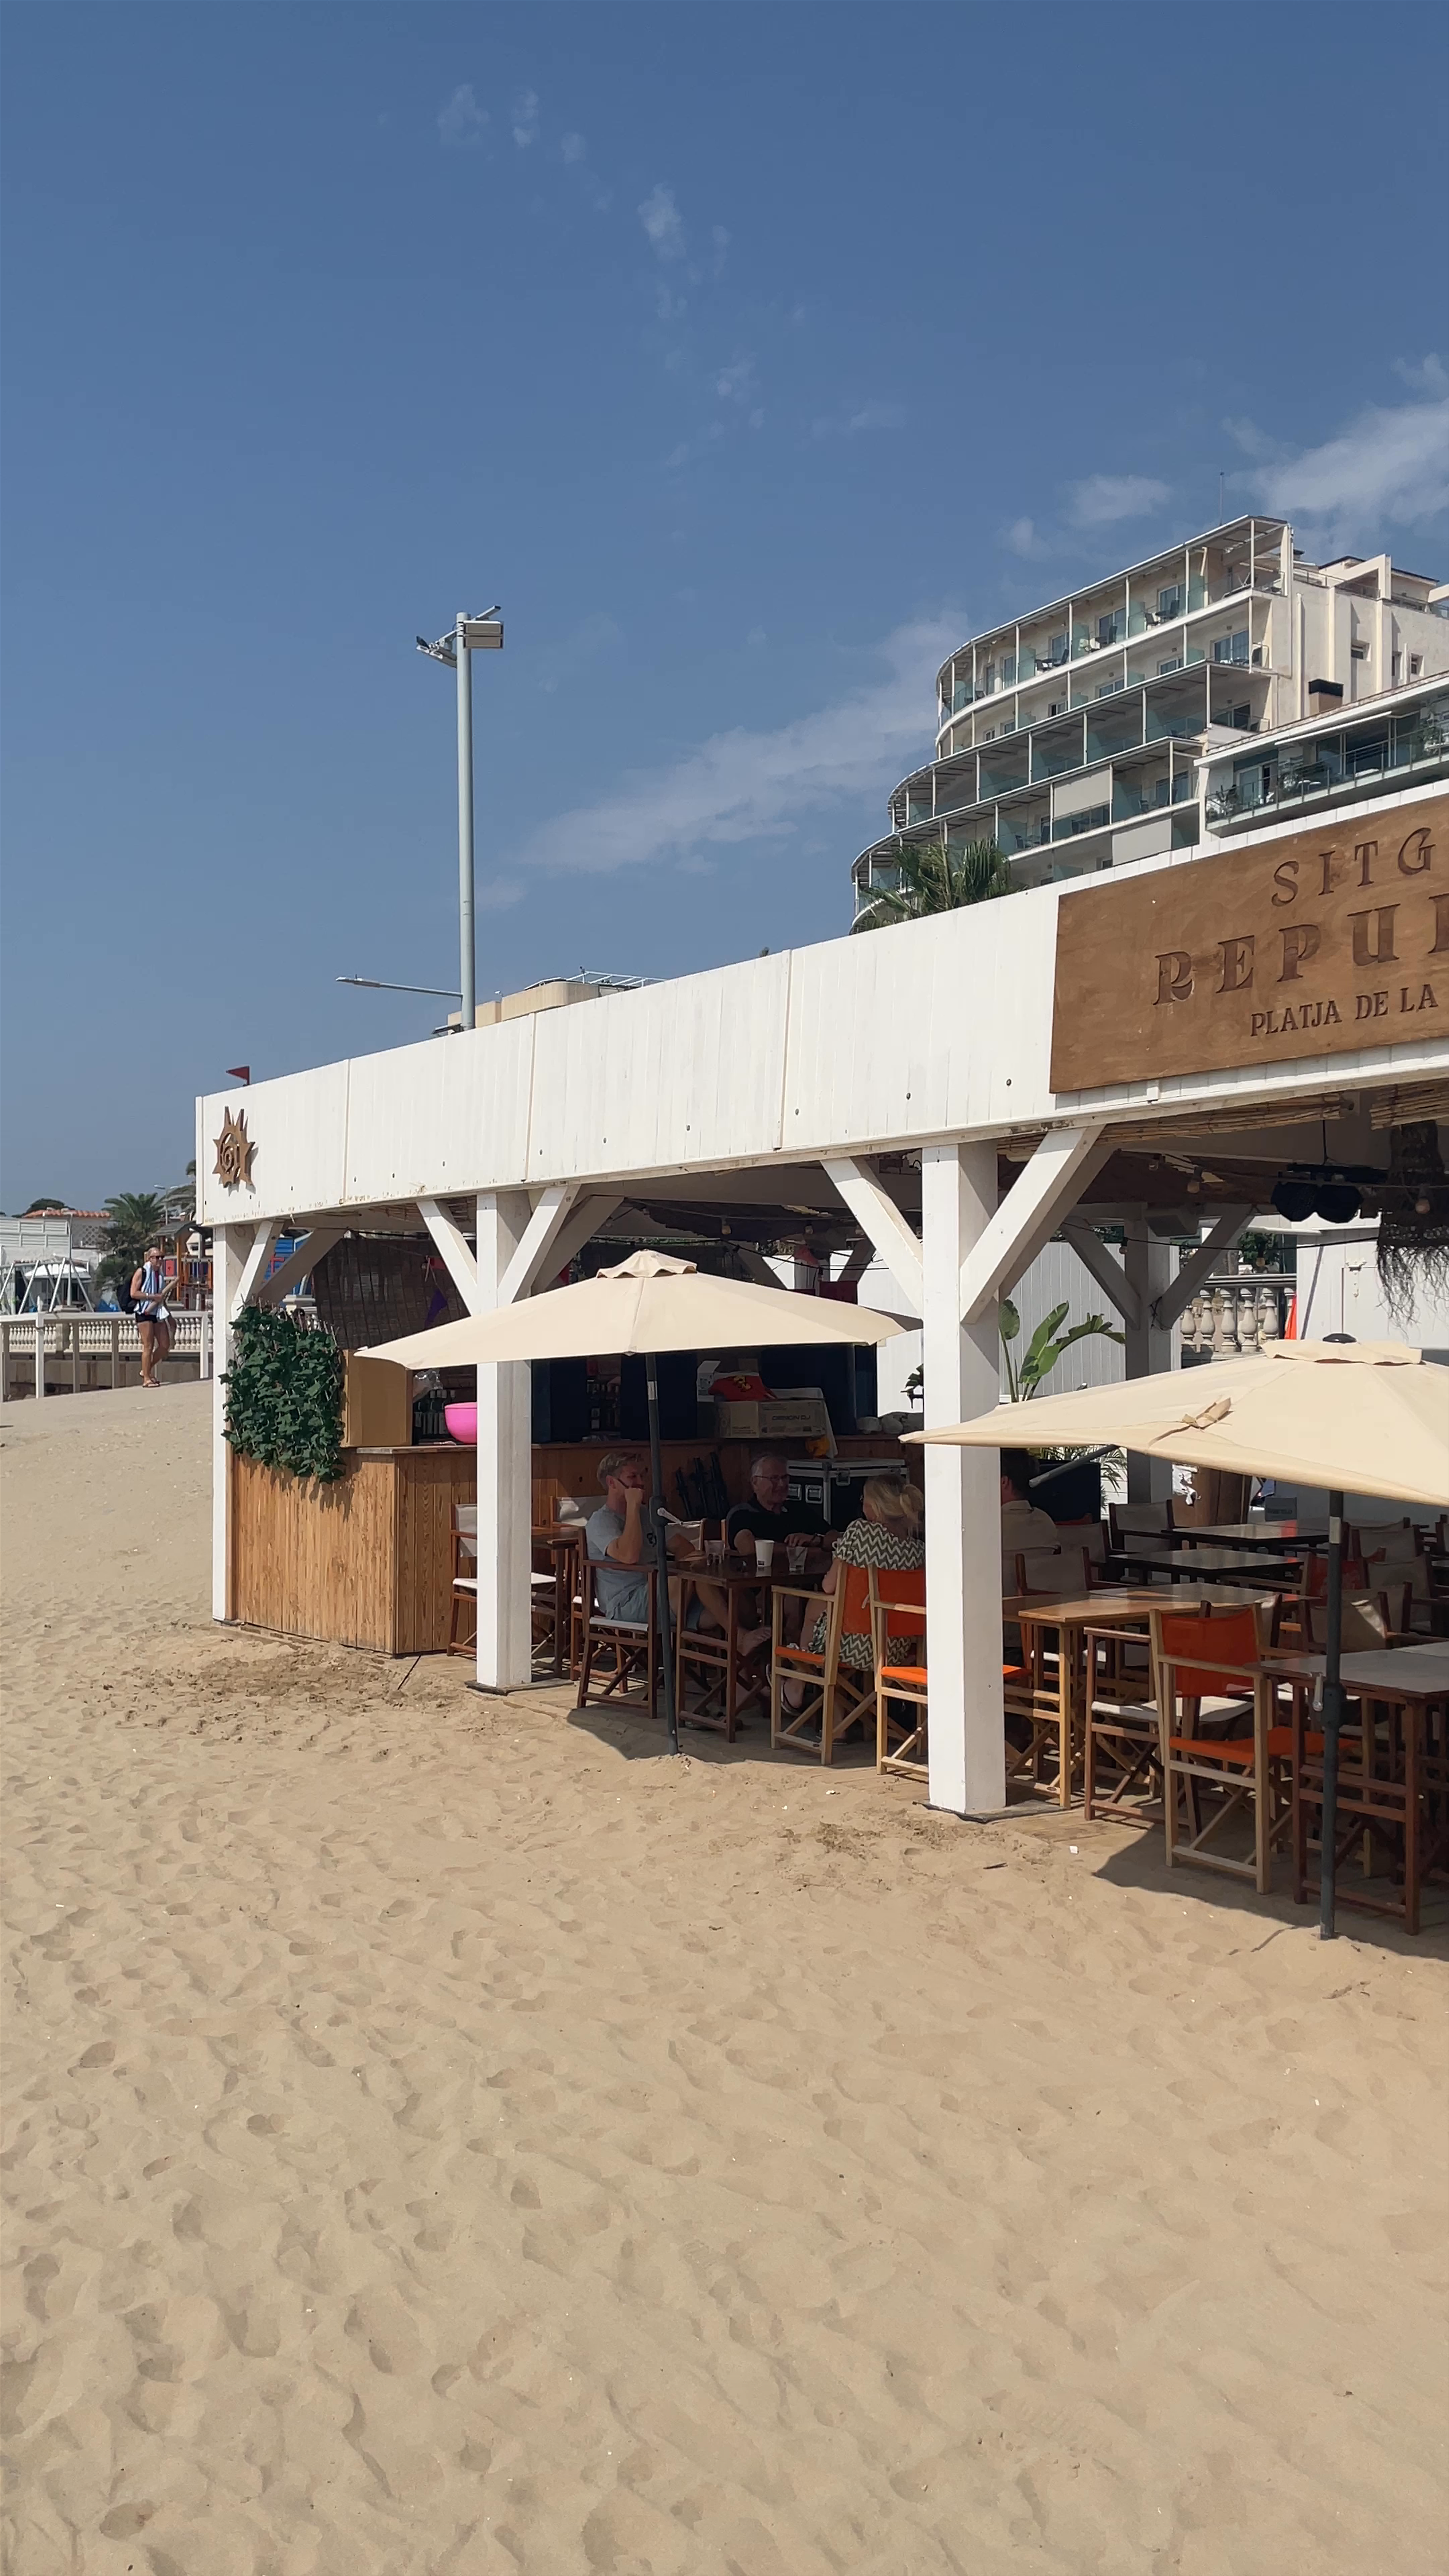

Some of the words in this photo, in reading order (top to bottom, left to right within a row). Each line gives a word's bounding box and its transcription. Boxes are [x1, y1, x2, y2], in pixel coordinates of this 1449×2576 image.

[1271, 827, 1436, 906] SITG
[1250, 1000, 1342, 1037] PLATJA
[1355, 991, 1389, 1020] DE
[1400, 984, 1439, 1012] LA
